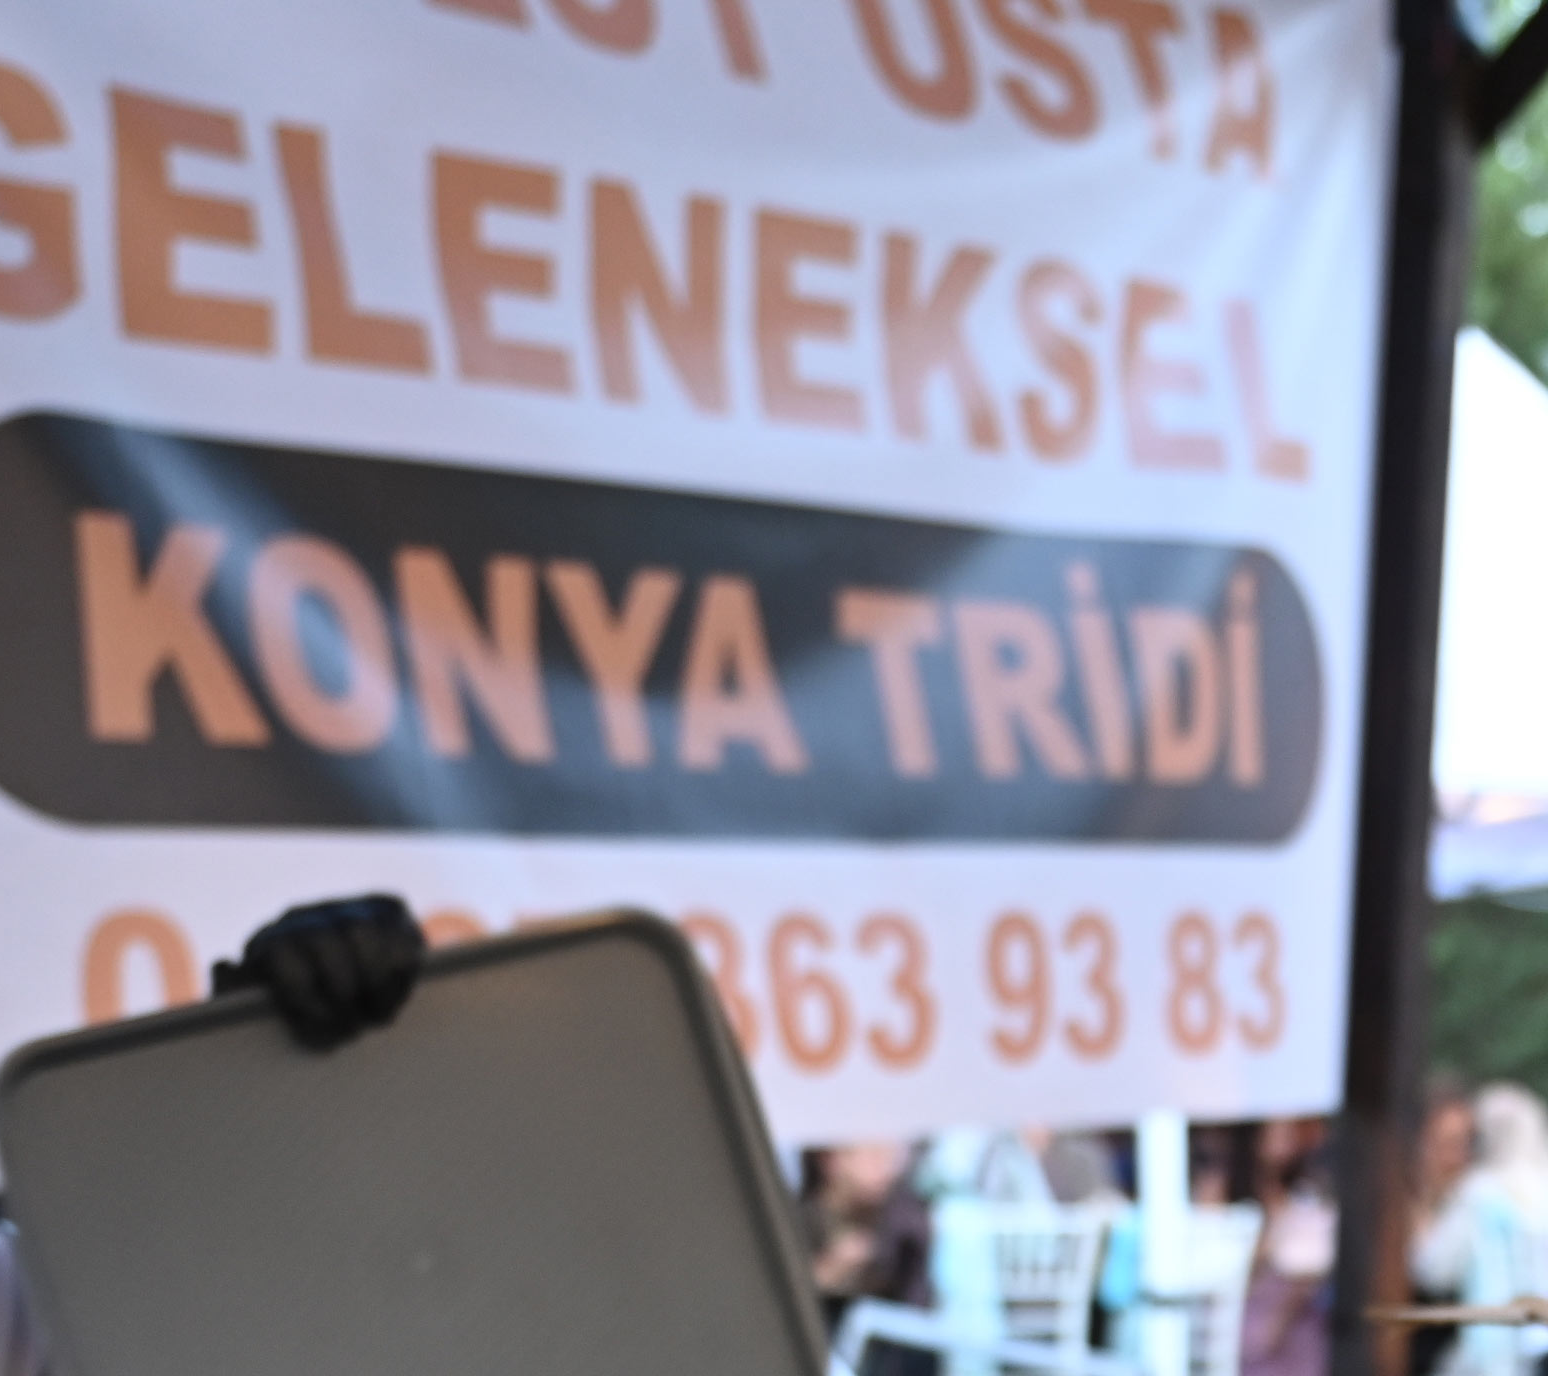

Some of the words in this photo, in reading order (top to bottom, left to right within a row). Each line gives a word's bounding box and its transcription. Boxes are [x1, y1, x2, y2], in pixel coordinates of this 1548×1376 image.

[75, 510, 809, 775] KONYA
[832, 560, 1270, 790] TRİDİ
[983, 908, 1122, 1066] 93
[1164, 912, 1288, 1056] 83
